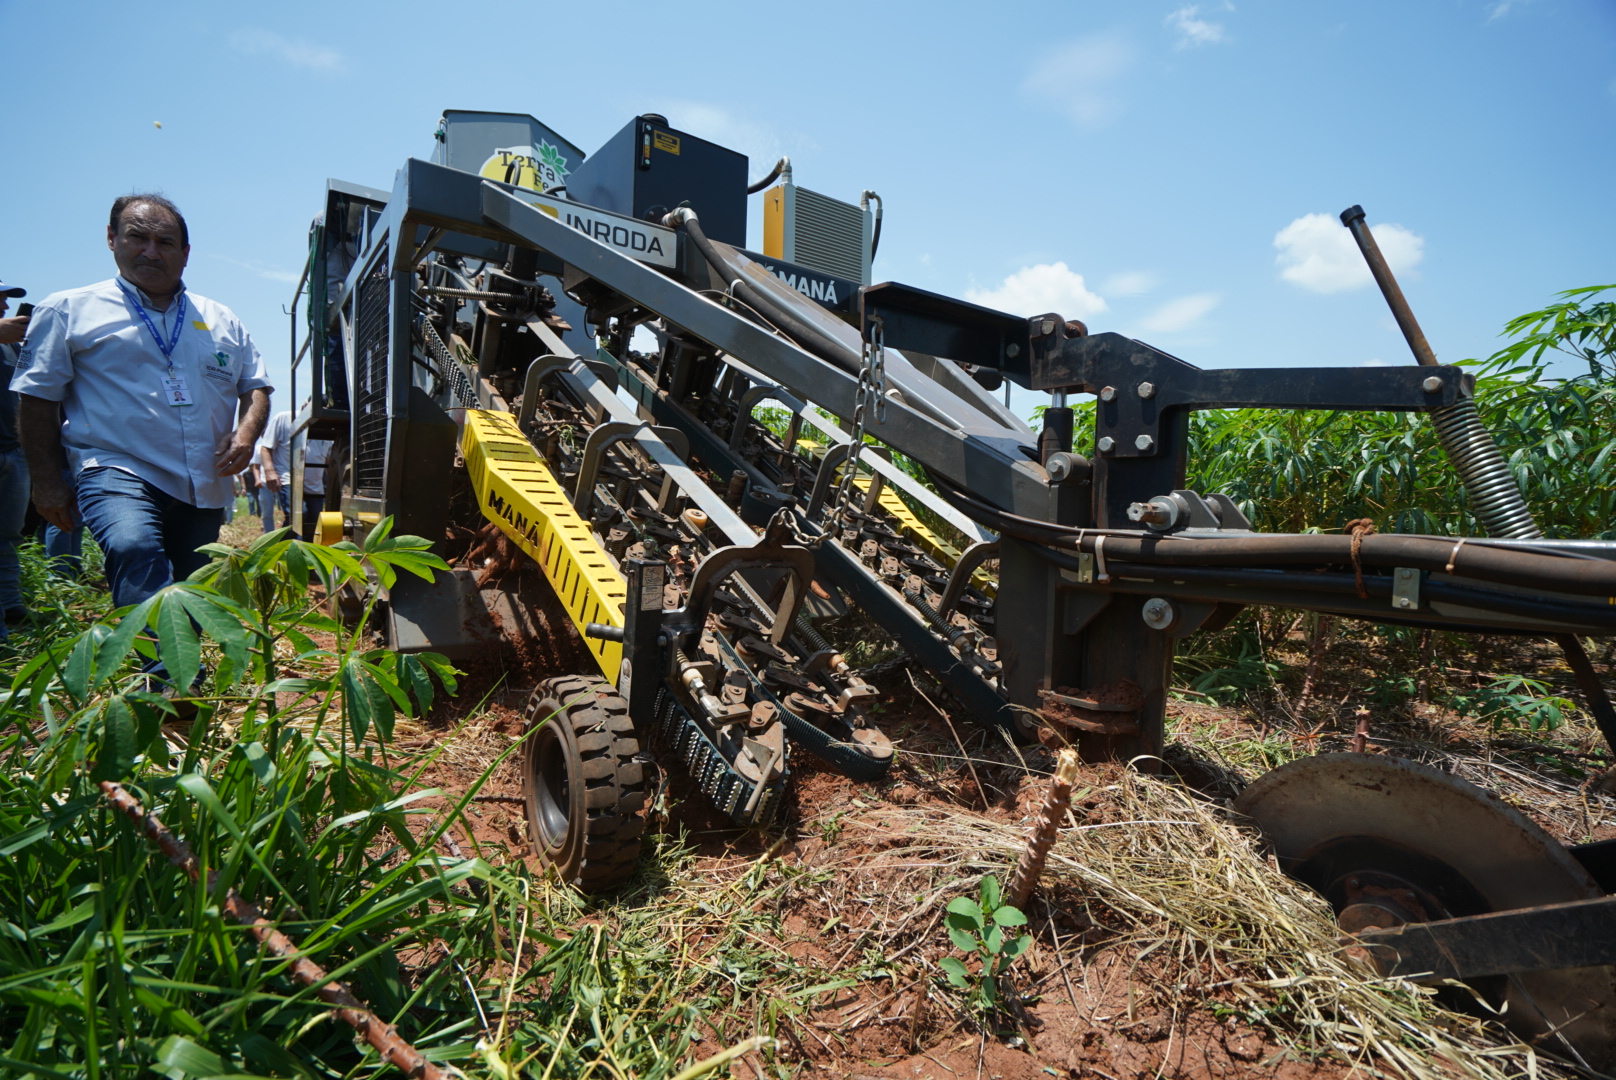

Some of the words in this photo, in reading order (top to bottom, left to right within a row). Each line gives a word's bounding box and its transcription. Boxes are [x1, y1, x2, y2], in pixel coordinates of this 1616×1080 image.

[498, 150, 556, 183] Terra
[566, 213, 664, 257] INRODA
[778, 270, 838, 305] MANÁ
[488, 488, 540, 549] MANÁ
